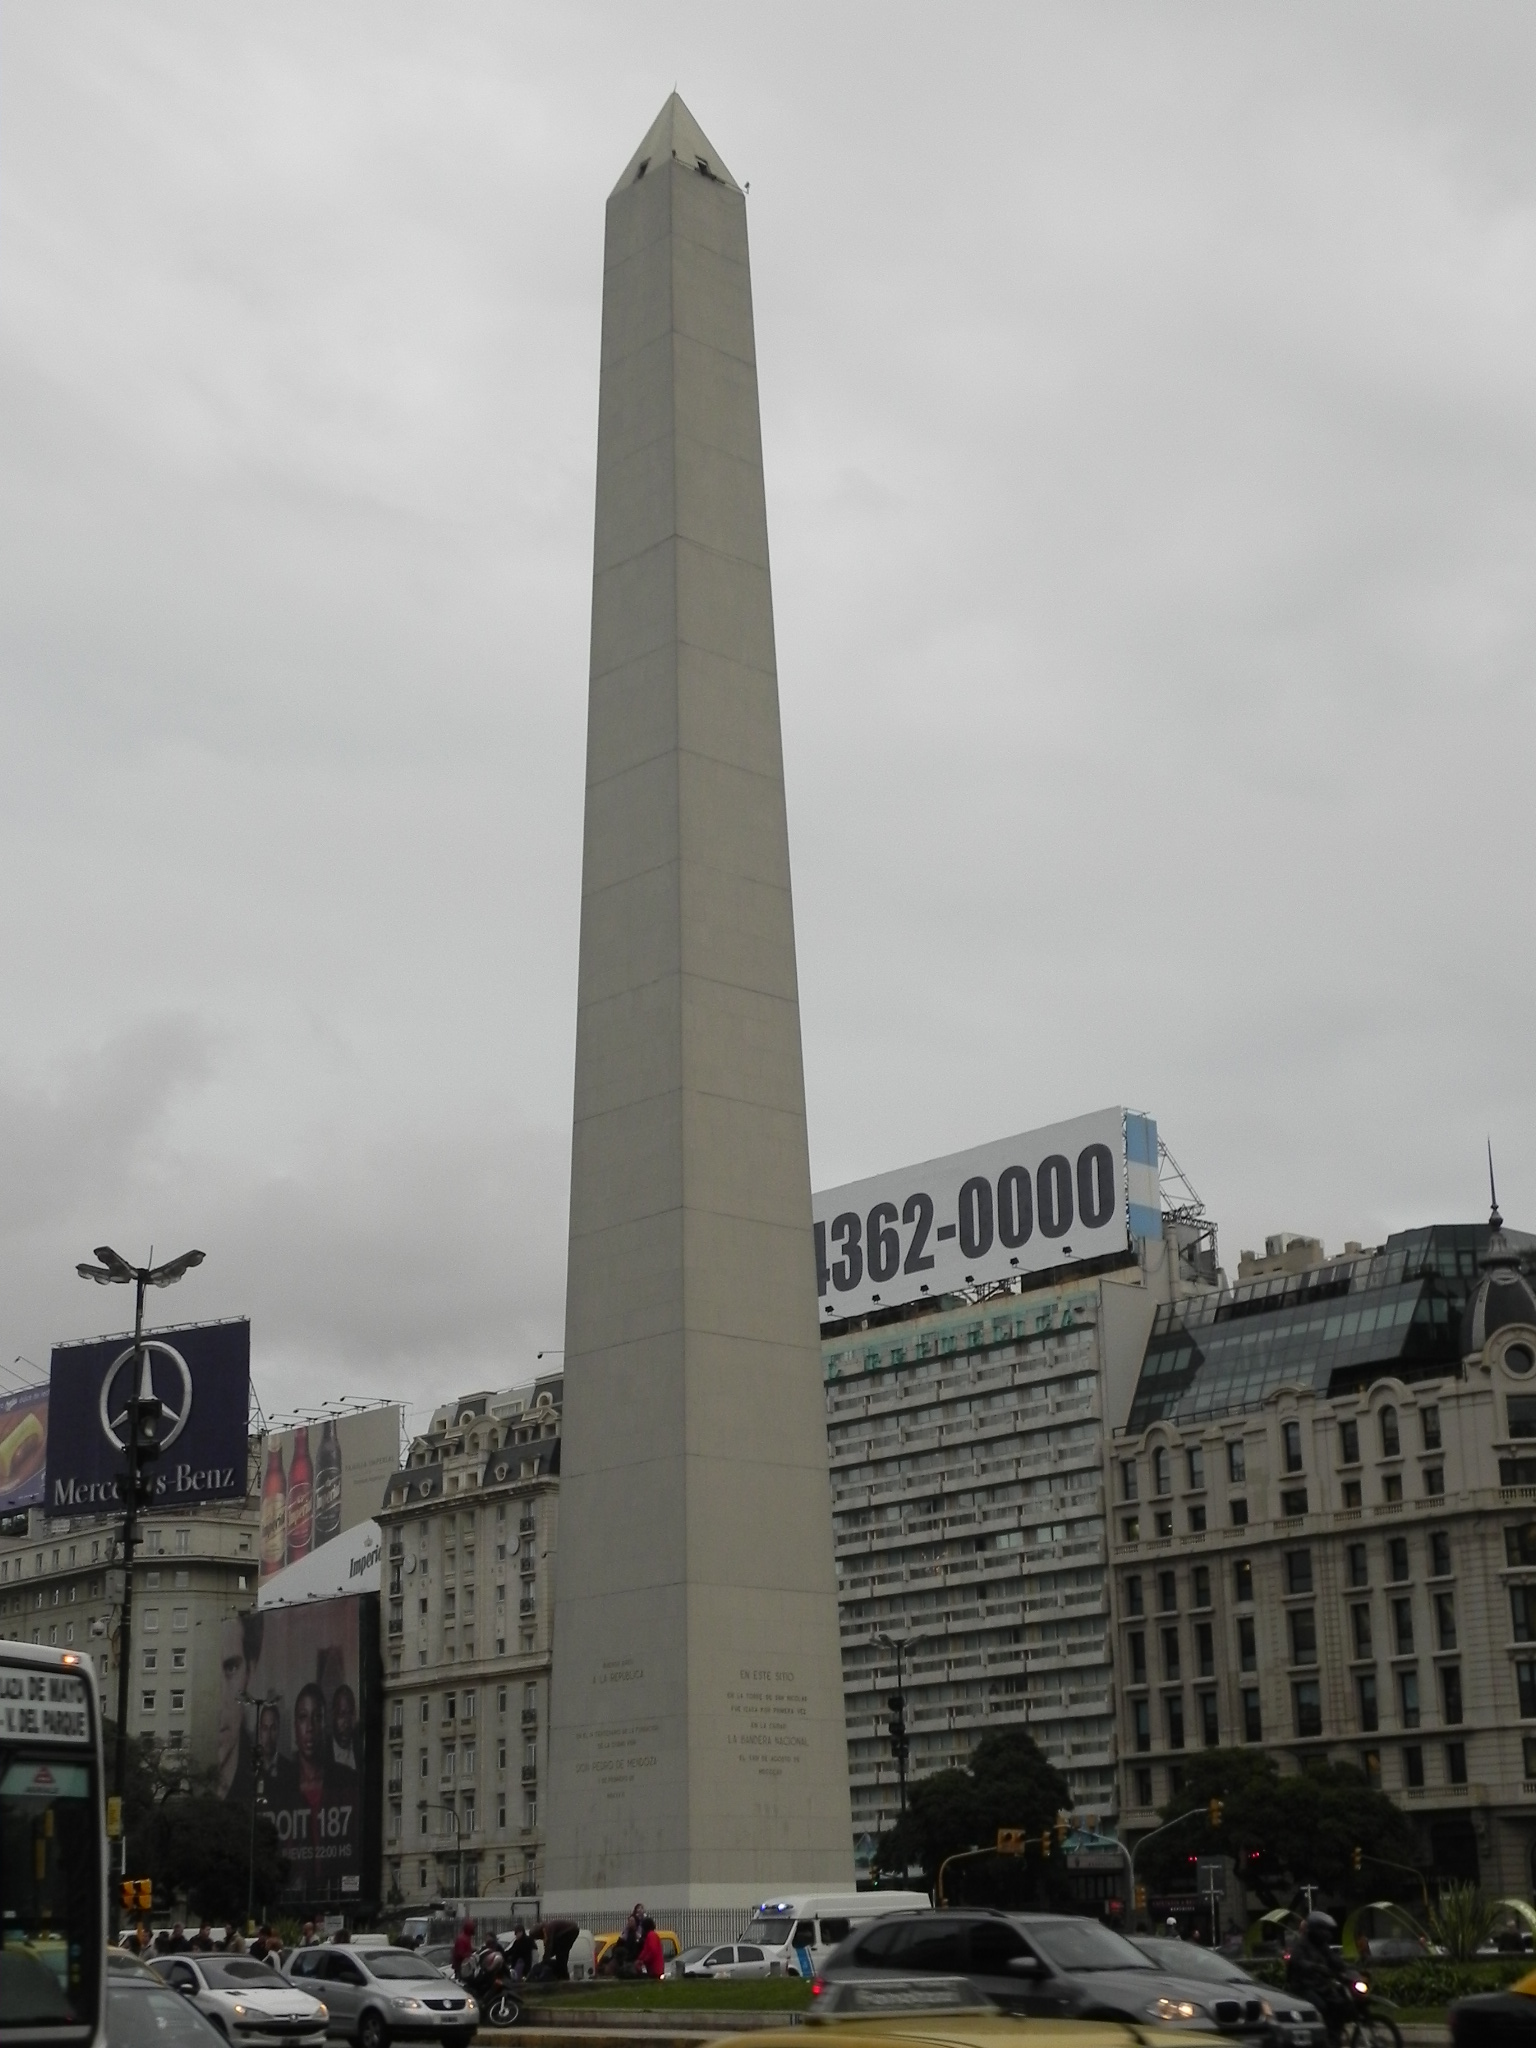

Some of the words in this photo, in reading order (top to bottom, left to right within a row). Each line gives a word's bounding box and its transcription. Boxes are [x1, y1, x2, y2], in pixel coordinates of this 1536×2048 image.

[813, 1143, 1115, 1297] 4362-0000
[54, 1463, 235, 1507] Mercs-Benz
[739, 1669, 750, 1680] EN
[753, 1670, 771, 1681] ESTE
[775, 1671, 795, 1682] SITIO
[317, 1805, 353, 1838] 187
[338, 1843, 353, 1857] HS
